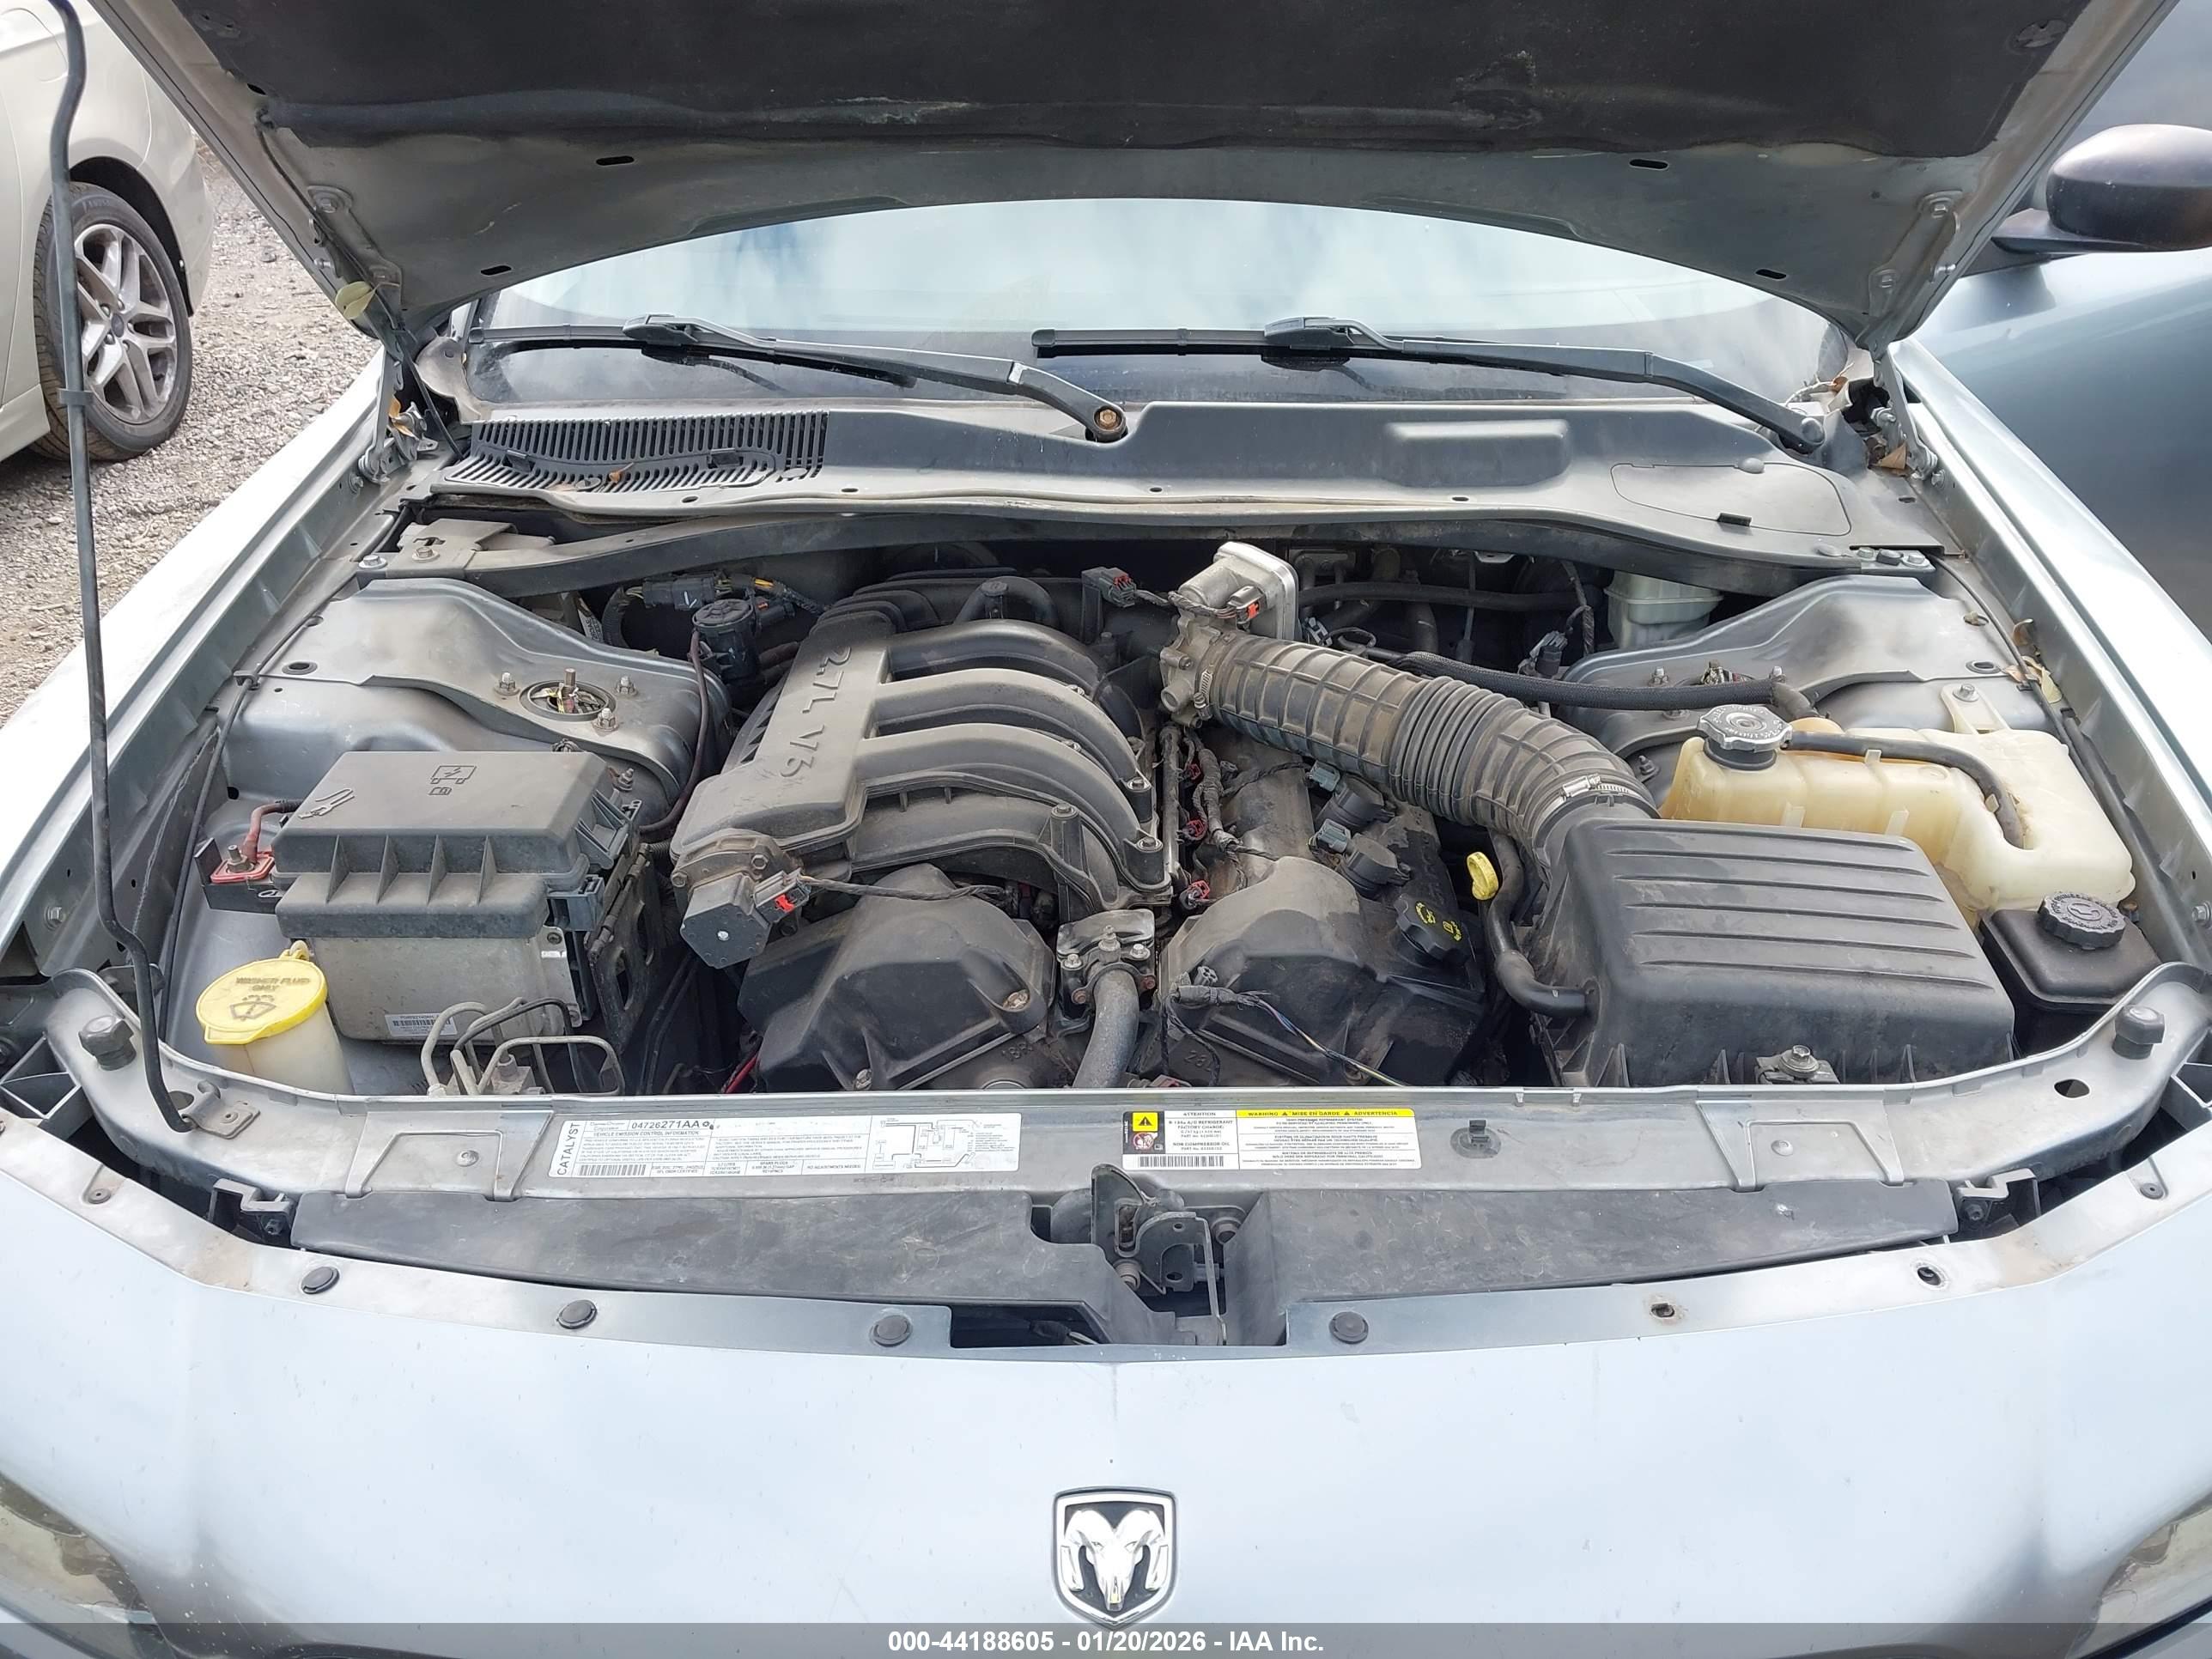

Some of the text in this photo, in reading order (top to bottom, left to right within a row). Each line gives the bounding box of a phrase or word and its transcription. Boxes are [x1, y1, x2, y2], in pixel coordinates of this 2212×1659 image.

[780, 646, 852, 778] 2.7L V6
[235, 976, 278, 985] WASHER
[631, 1120, 701, 1130] 04726271AA
[556, 1122, 581, 1176] CATALYST
